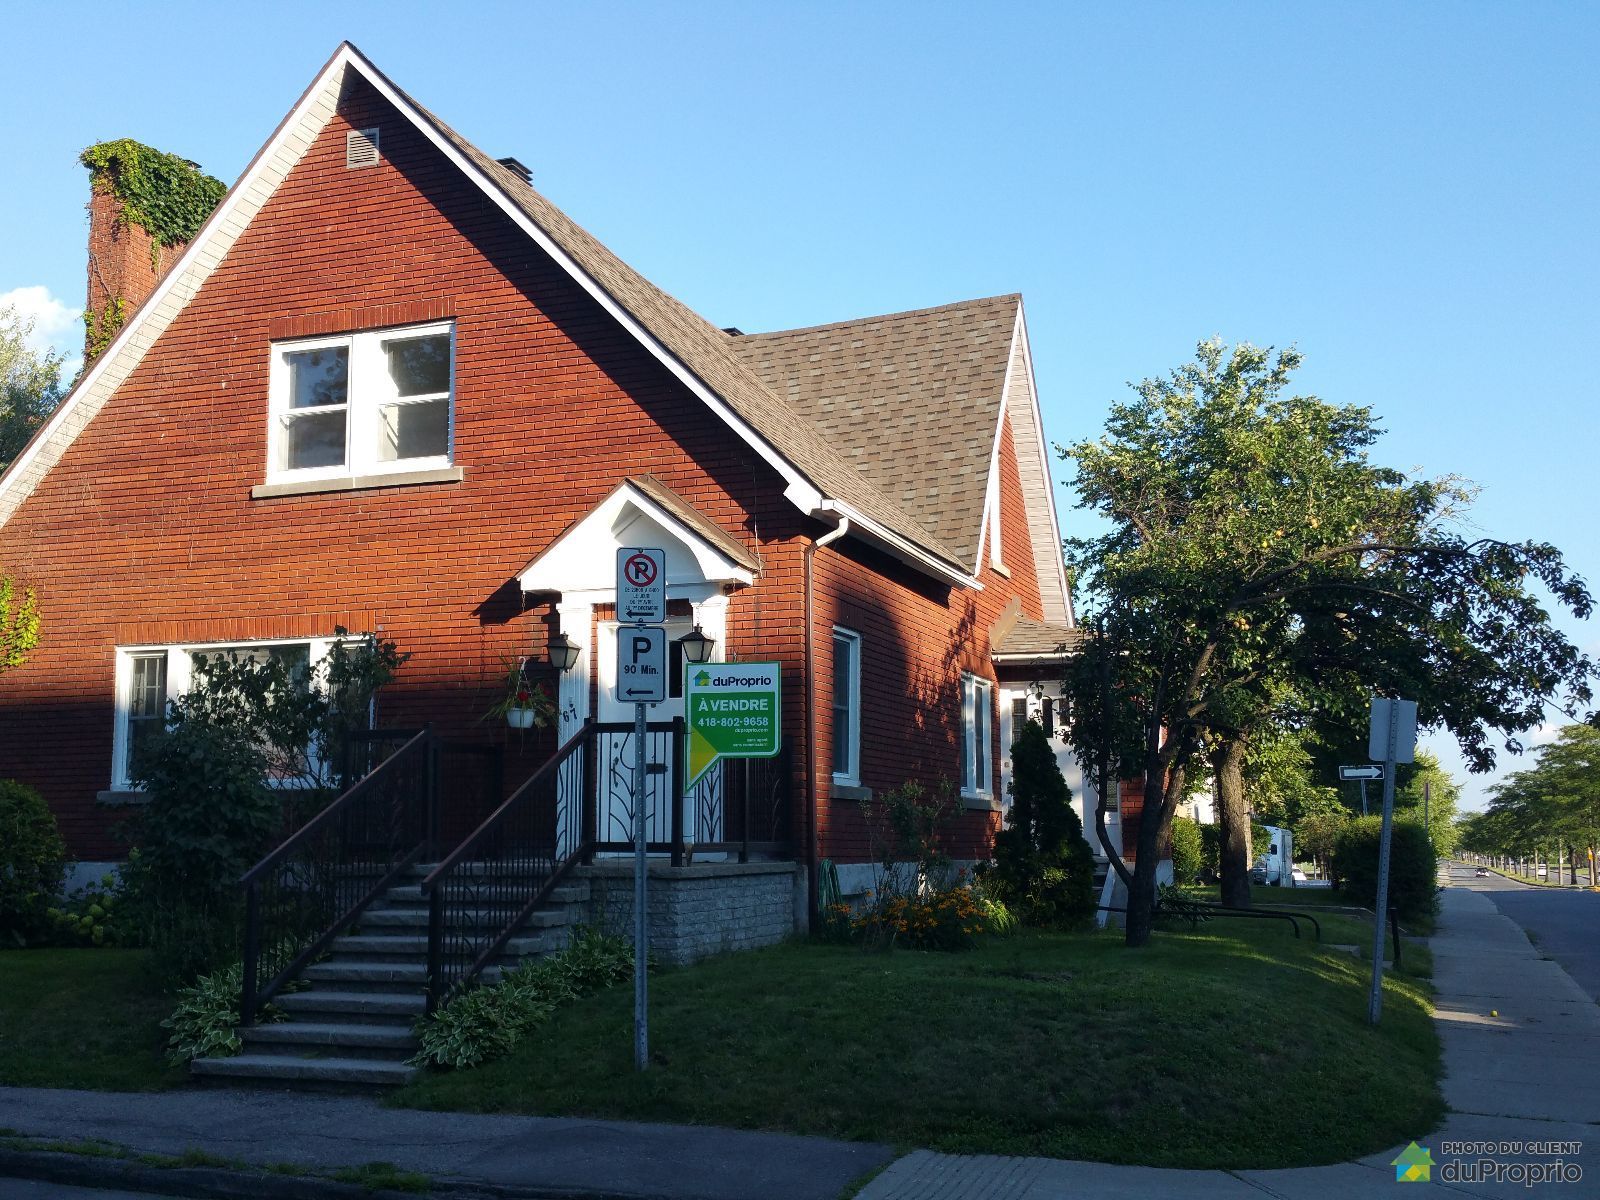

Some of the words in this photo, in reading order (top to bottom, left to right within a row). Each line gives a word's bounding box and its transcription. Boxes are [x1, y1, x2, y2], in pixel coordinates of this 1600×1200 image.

[632, 636, 652, 664] P
[624, 665, 637, 674] 90
[641, 665, 659, 675] Min.
[712, 675, 772, 688] duProprio
[698, 697, 709, 712] À
[709, 698, 769, 712] VENDRE
[698, 717, 769, 727] 418-802-9658
